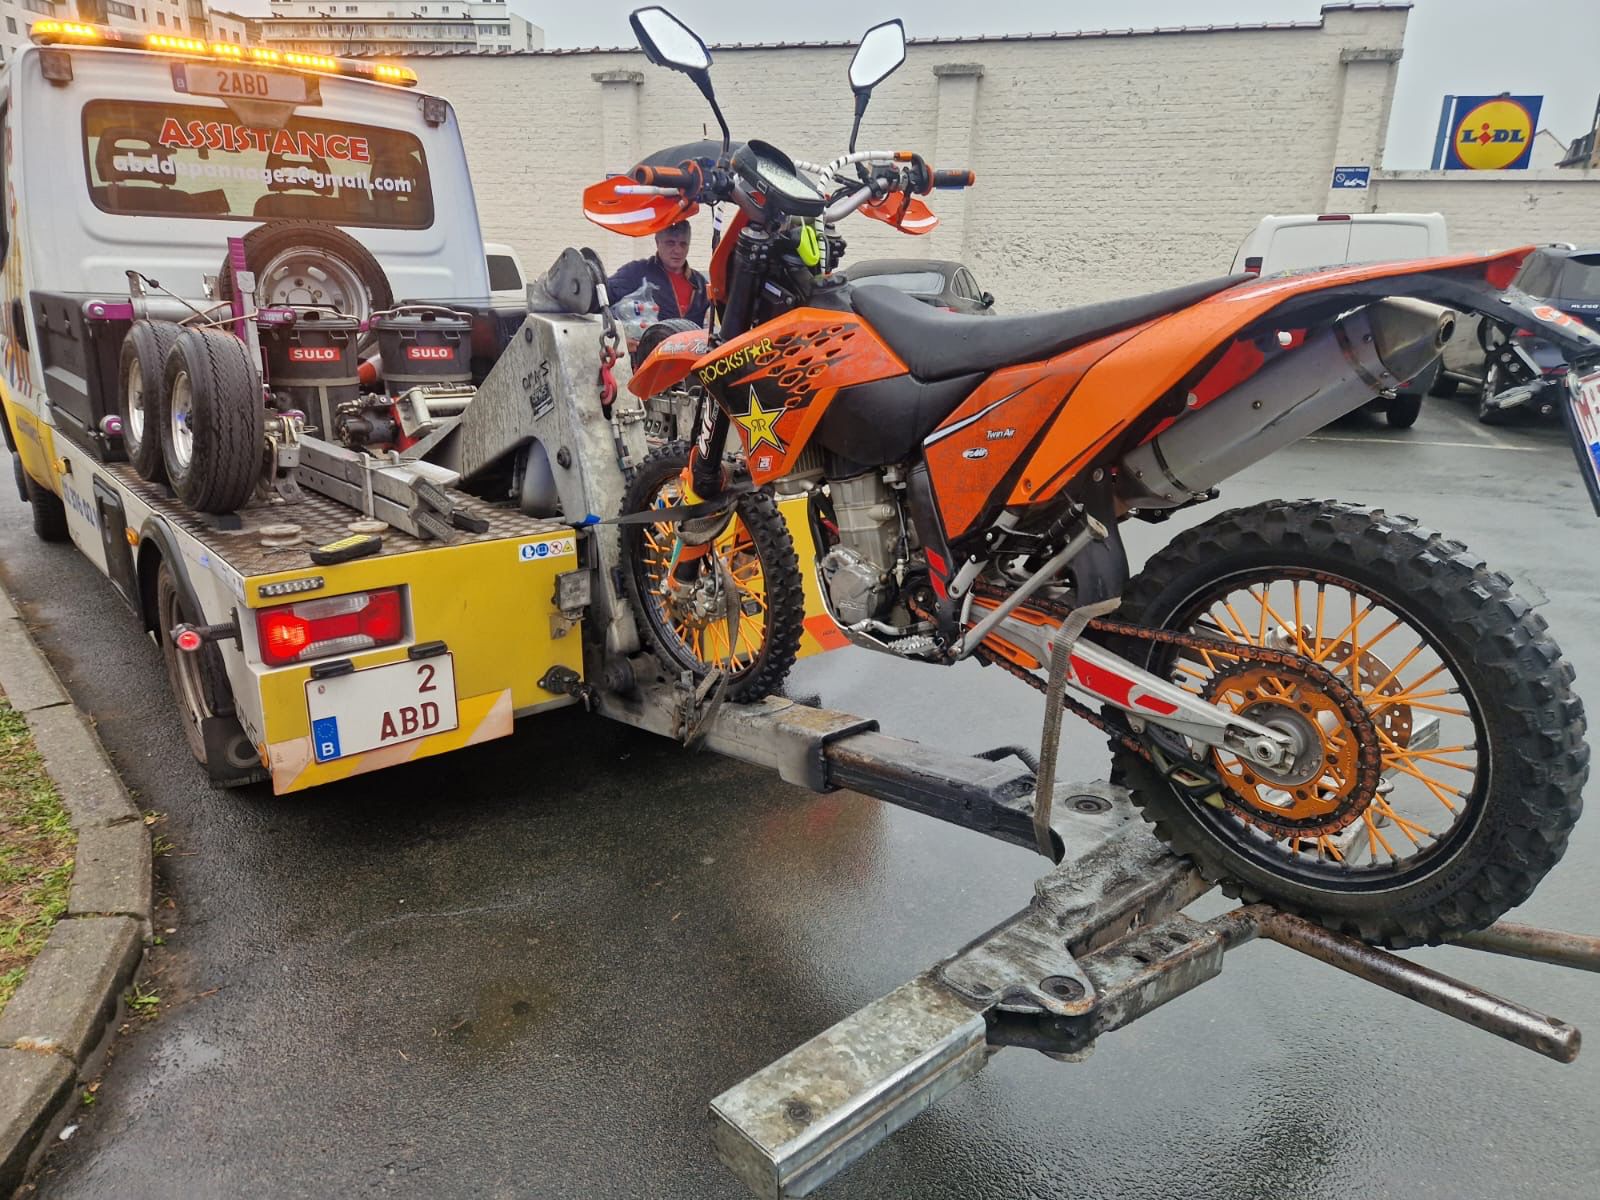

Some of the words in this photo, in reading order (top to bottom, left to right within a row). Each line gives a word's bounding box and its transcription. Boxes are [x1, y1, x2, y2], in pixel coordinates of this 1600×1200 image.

[217, 71, 269, 96] 2ABD
[159, 117, 370, 162] ASSISTANCE
[294, 350, 334, 359] SULO
[411, 348, 448, 358] SULO
[417, 664, 437, 693] 2
[381, 702, 440, 741] ABD
[321, 742, 335, 756] B
